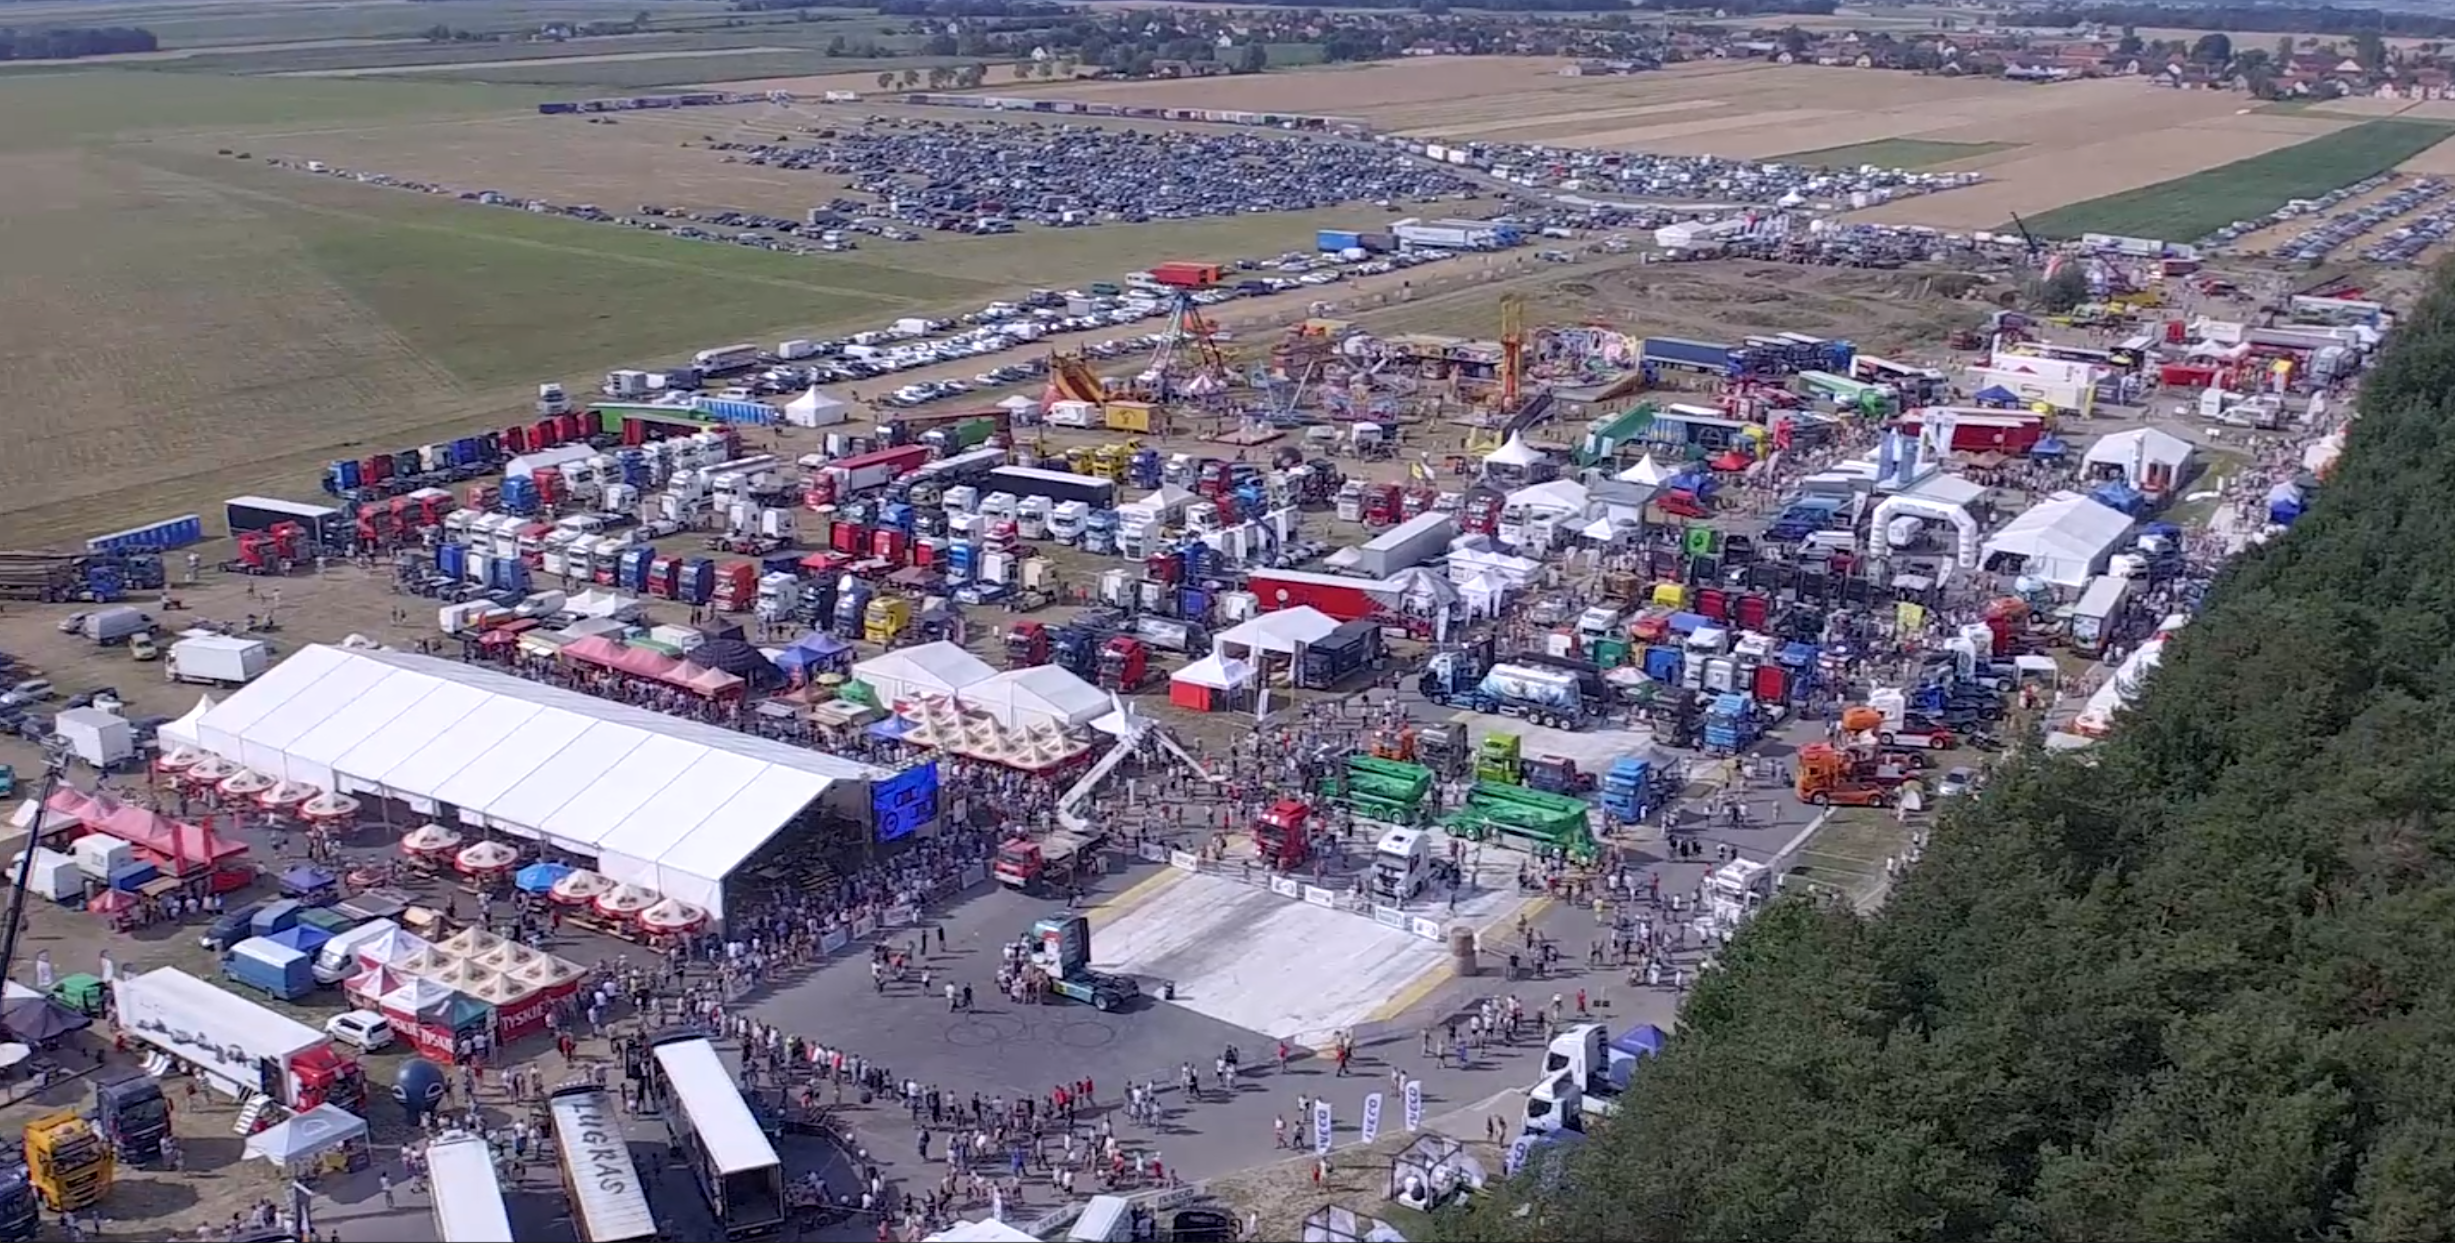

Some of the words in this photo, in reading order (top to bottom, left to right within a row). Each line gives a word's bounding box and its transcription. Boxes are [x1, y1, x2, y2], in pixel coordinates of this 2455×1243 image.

[501, 1000, 546, 1031] TYSKIE
[420, 1027, 455, 1054] TYSKIE
[1364, 1098, 1378, 1139] IVECO
[1408, 1086, 1418, 1126] IVECO
[572, 1103, 626, 1195] LUGRAS
[1318, 1109, 1329, 1149] IVECO
[1158, 1188, 1195, 1204] IVECO
